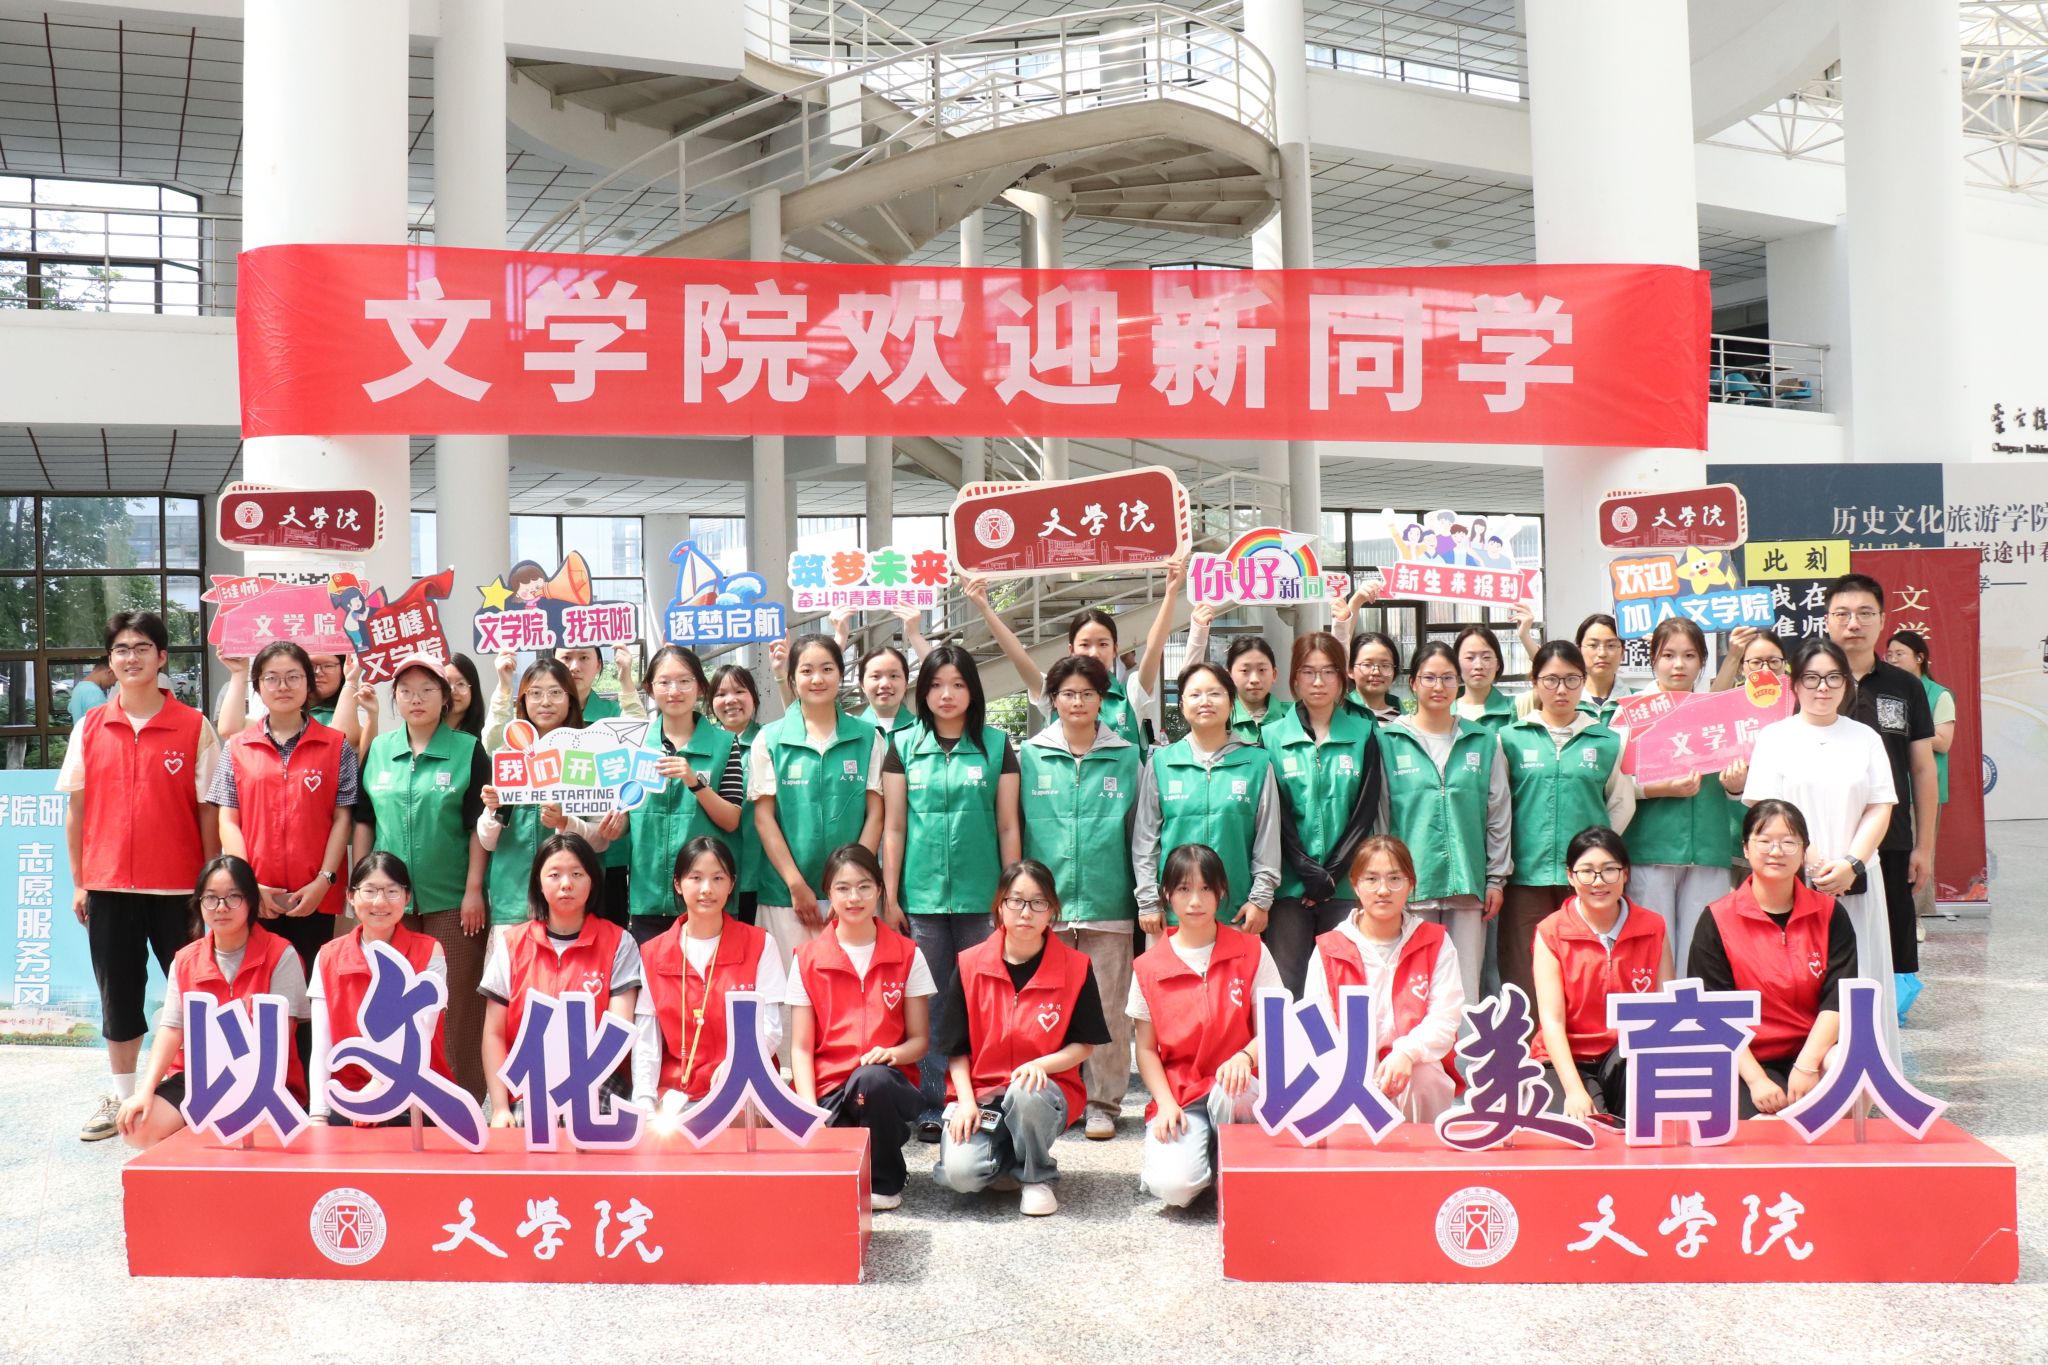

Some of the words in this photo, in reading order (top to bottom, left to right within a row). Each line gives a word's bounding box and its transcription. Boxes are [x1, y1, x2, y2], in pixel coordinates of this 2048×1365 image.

[362, 277, 1574, 415] 文学院欢迎新同学
[279, 506, 361, 532] 文学院
[1038, 499, 1155, 537] 文学院
[1651, 504, 1726, 528] 文学院
[1832, 504, 2048, 535] 历史文化旅游学院
[791, 549, 949, 589] 筑梦未来
[1763, 545, 1828, 573] 此刻
[1395, 567, 1519, 600] 新生来报到
[1616, 561, 1674, 595] 欢迎
[797, 589, 934, 608] 奋斗的青春最美丽
[253, 613, 337, 638] 文学院
[669, 606, 782, 641] 逐梦启航
[499, 755, 659, 786] 我们开学啦
[552, 788, 614, 801] STARTING
[13, 841, 55, 1007] 志愿服务岗
[180, 940, 832, 1153] 以文化人
[1253, 977, 1949, 1152] 以美育人
[431, 1196, 664, 1264] 文学院
[1567, 1191, 1815, 1261] 文学院
